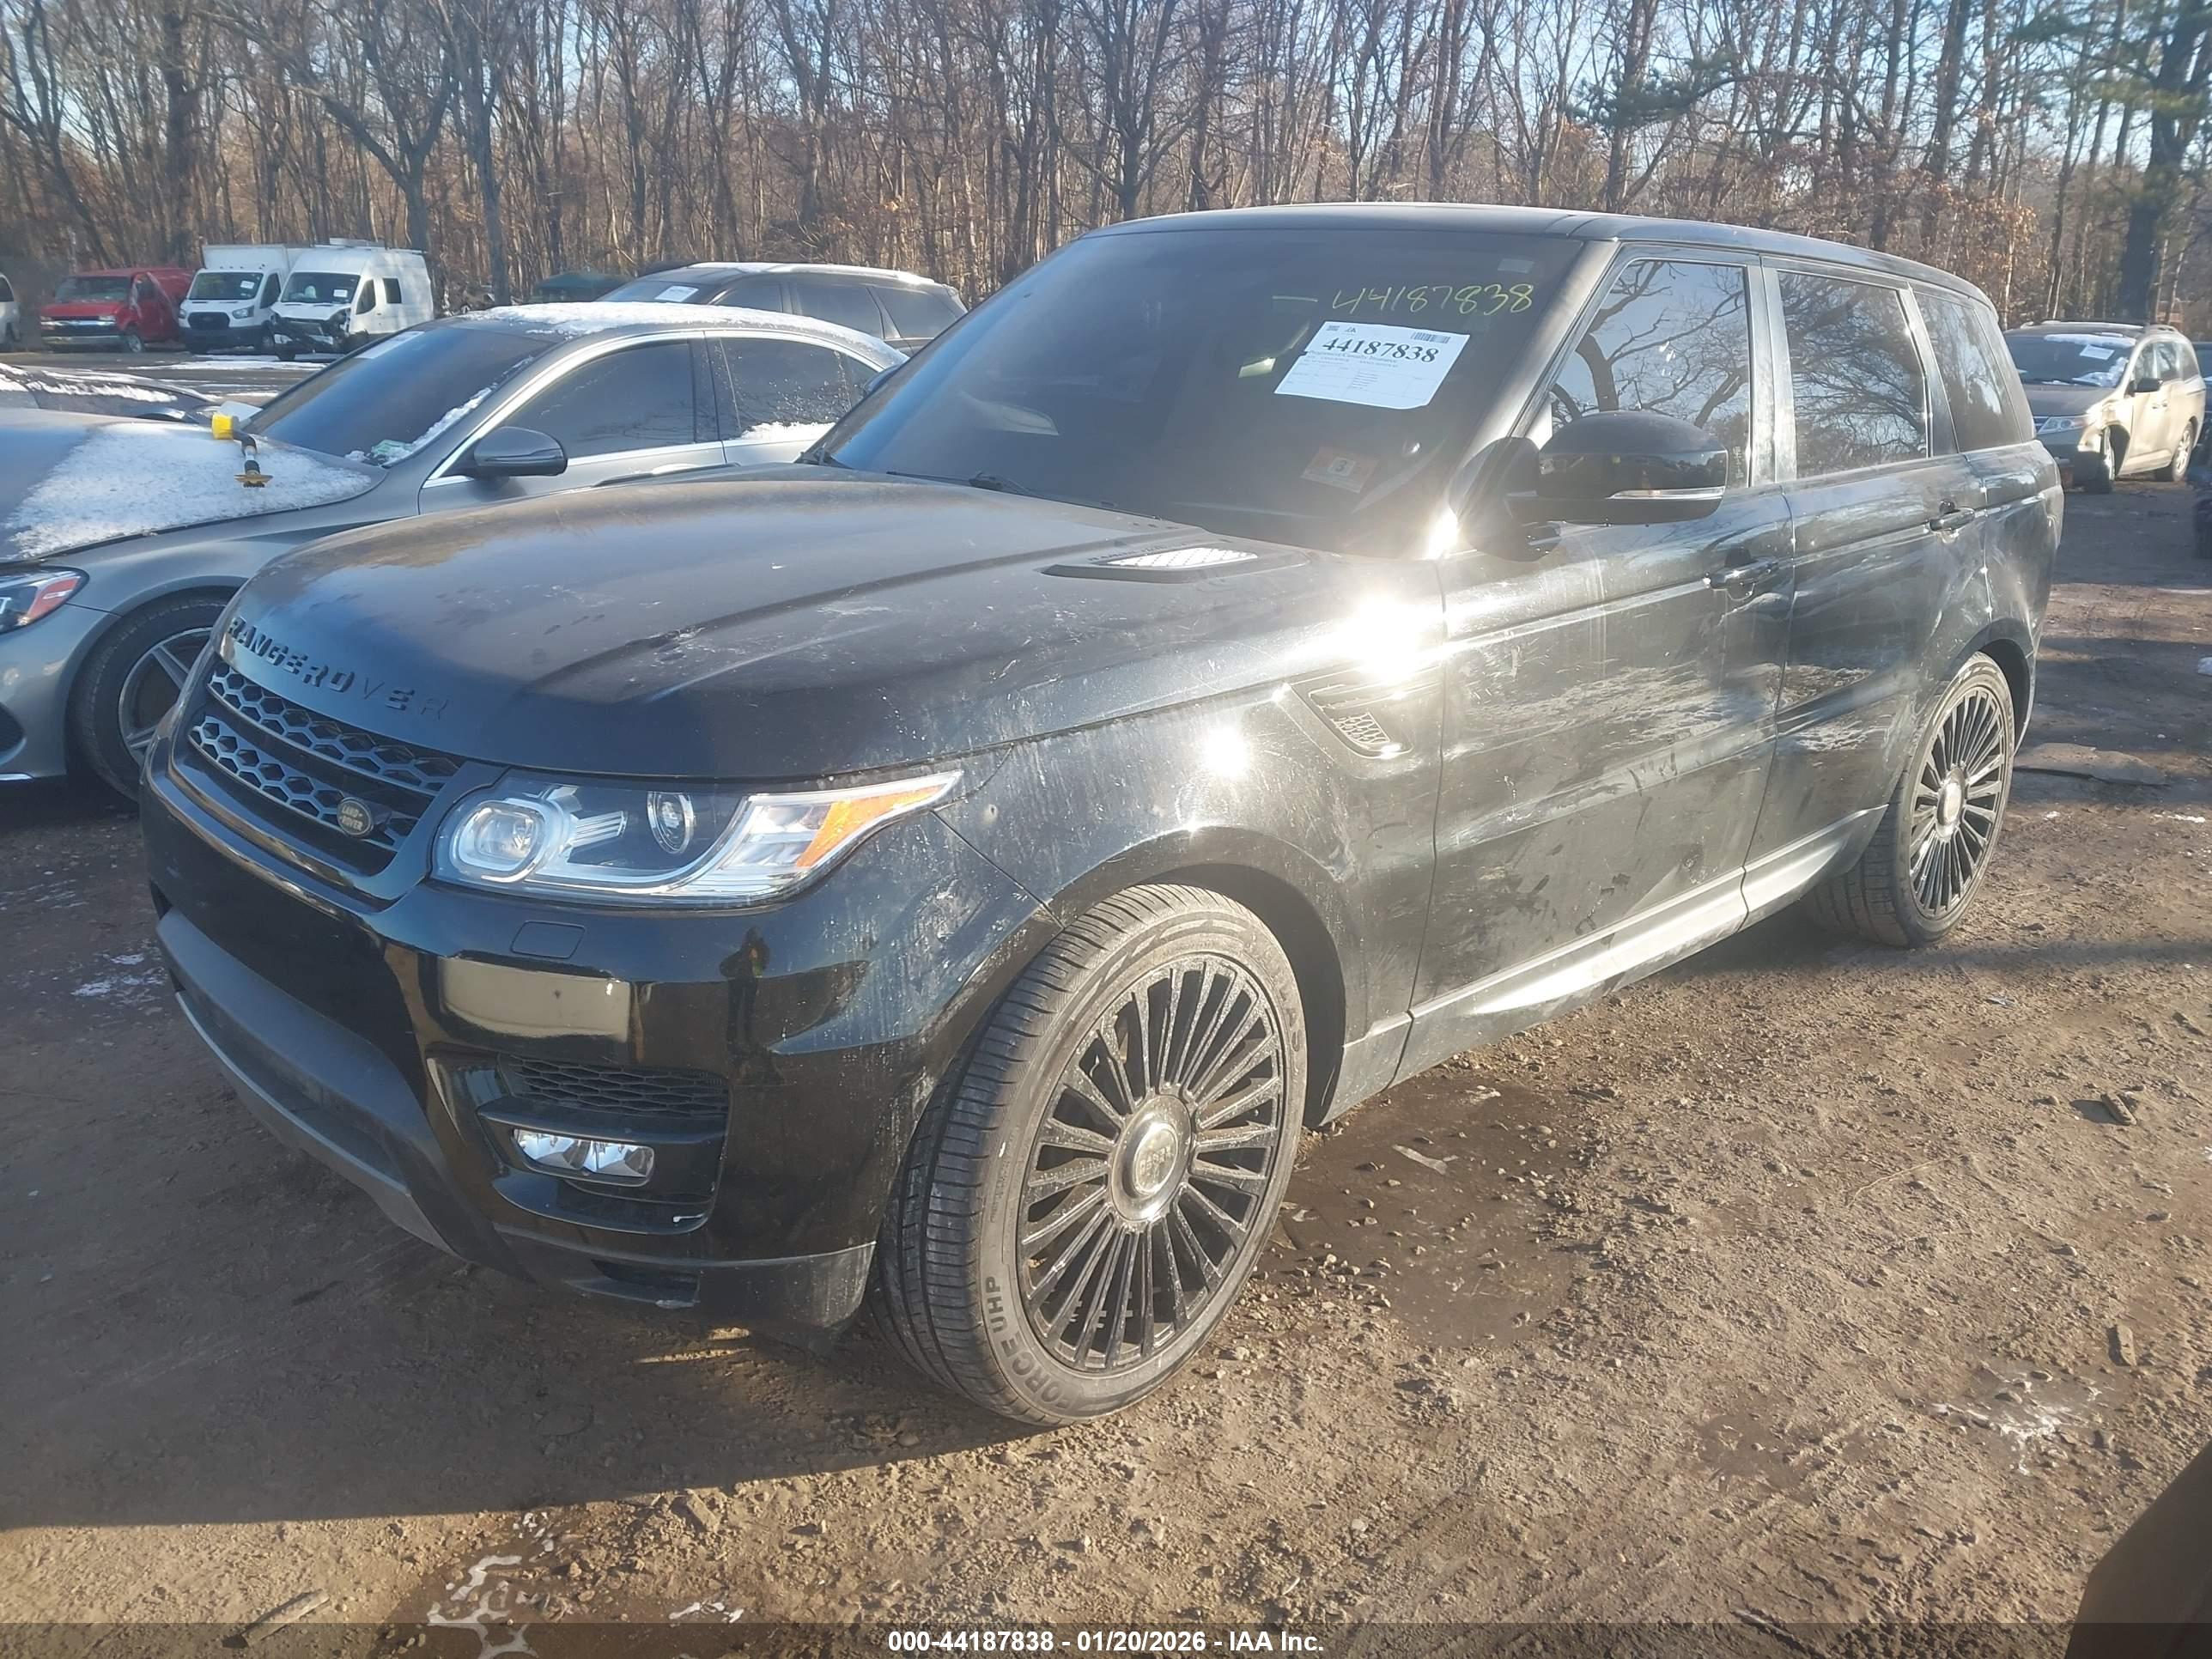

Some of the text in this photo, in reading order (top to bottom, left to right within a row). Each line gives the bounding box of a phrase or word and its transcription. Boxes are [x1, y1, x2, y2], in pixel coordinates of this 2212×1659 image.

[1333, 283, 1534, 315] 44187838
[1322, 337, 1440, 363] 44187838
[228, 615, 450, 720] RANGE ROVER
[985, 1276, 1008, 1334] UHP
